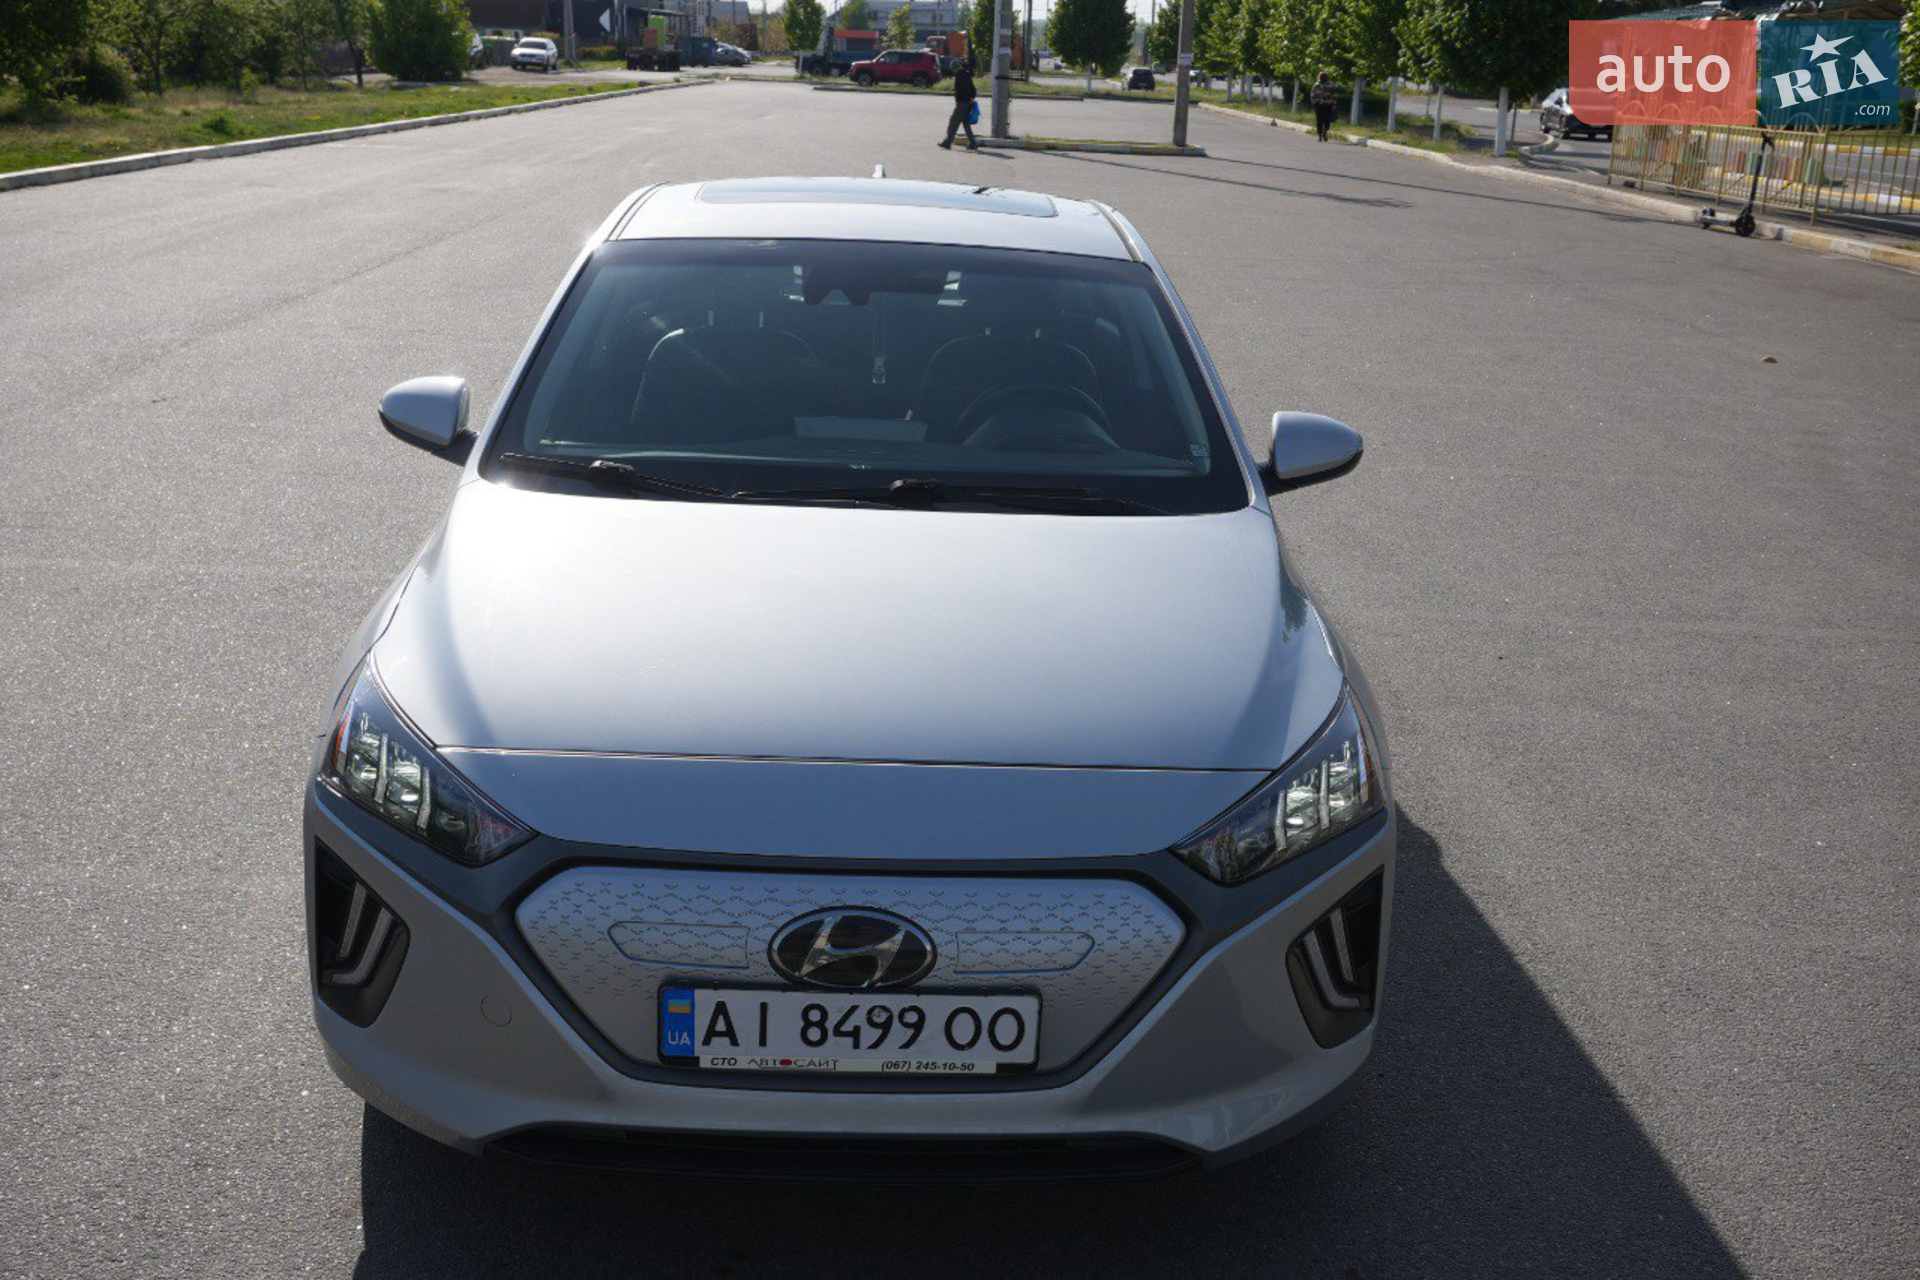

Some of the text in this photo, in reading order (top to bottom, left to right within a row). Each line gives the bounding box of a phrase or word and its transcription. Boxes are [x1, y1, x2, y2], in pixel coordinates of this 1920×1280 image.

[702, 1001, 769, 1047] AI
[801, 1003, 926, 1050] 8499
[668, 1032, 691, 1045] UA
[710, 1057, 738, 1066] СТО
[881, 1060, 975, 1071] (067) 245-10-50
